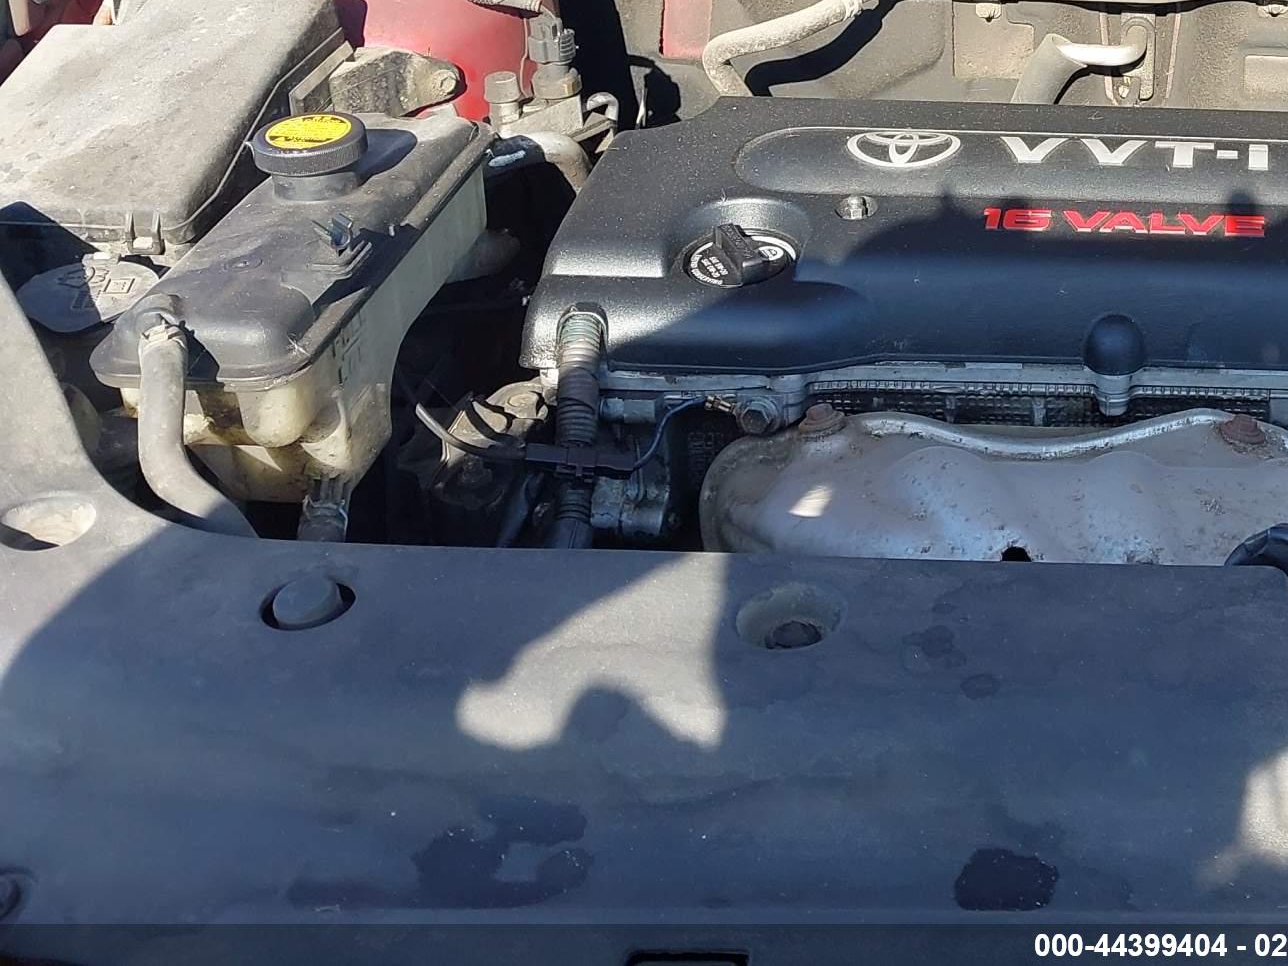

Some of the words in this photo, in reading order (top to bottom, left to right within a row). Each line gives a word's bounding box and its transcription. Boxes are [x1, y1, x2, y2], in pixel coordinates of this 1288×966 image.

[1000, 136, 1269, 171] VVT-I
[984, 207, 1051, 232] 16
[1063, 210, 1265, 237] VALVE
